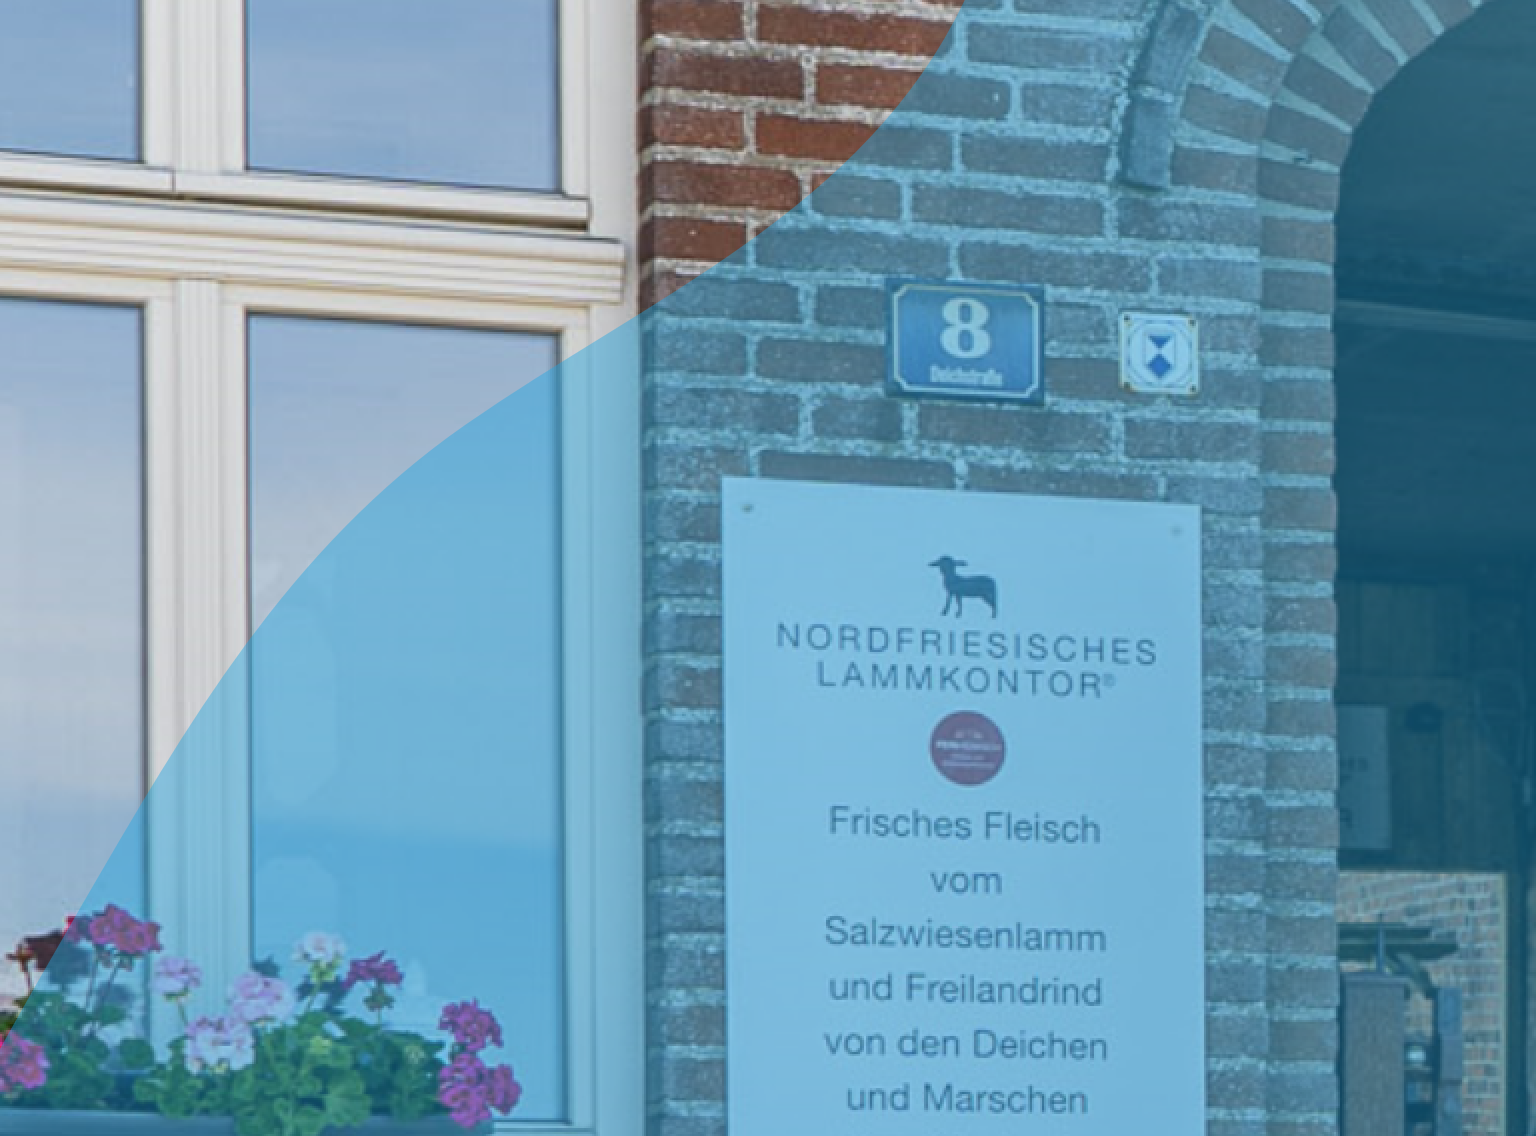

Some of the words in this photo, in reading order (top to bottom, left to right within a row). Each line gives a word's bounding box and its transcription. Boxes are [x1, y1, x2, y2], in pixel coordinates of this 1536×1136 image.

[939, 297, 992, 359] 8
[776, 622, 1158, 666] NORDFRIESISCHES
[829, 805, 972, 840] Frisches
[984, 811, 1101, 844] Fleisch
[929, 871, 1003, 895] vom
[824, 916, 1107, 952] Salzwiesenlamm
[828, 973, 892, 1002] und
[905, 972, 1103, 1007] Freilandrind
[824, 1032, 885, 1057] von
[897, 1029, 960, 1058] den
[973, 1030, 1108, 1061] Deichen
[846, 1083, 910, 1112] und
[923, 1082, 1089, 1115] Marschen
